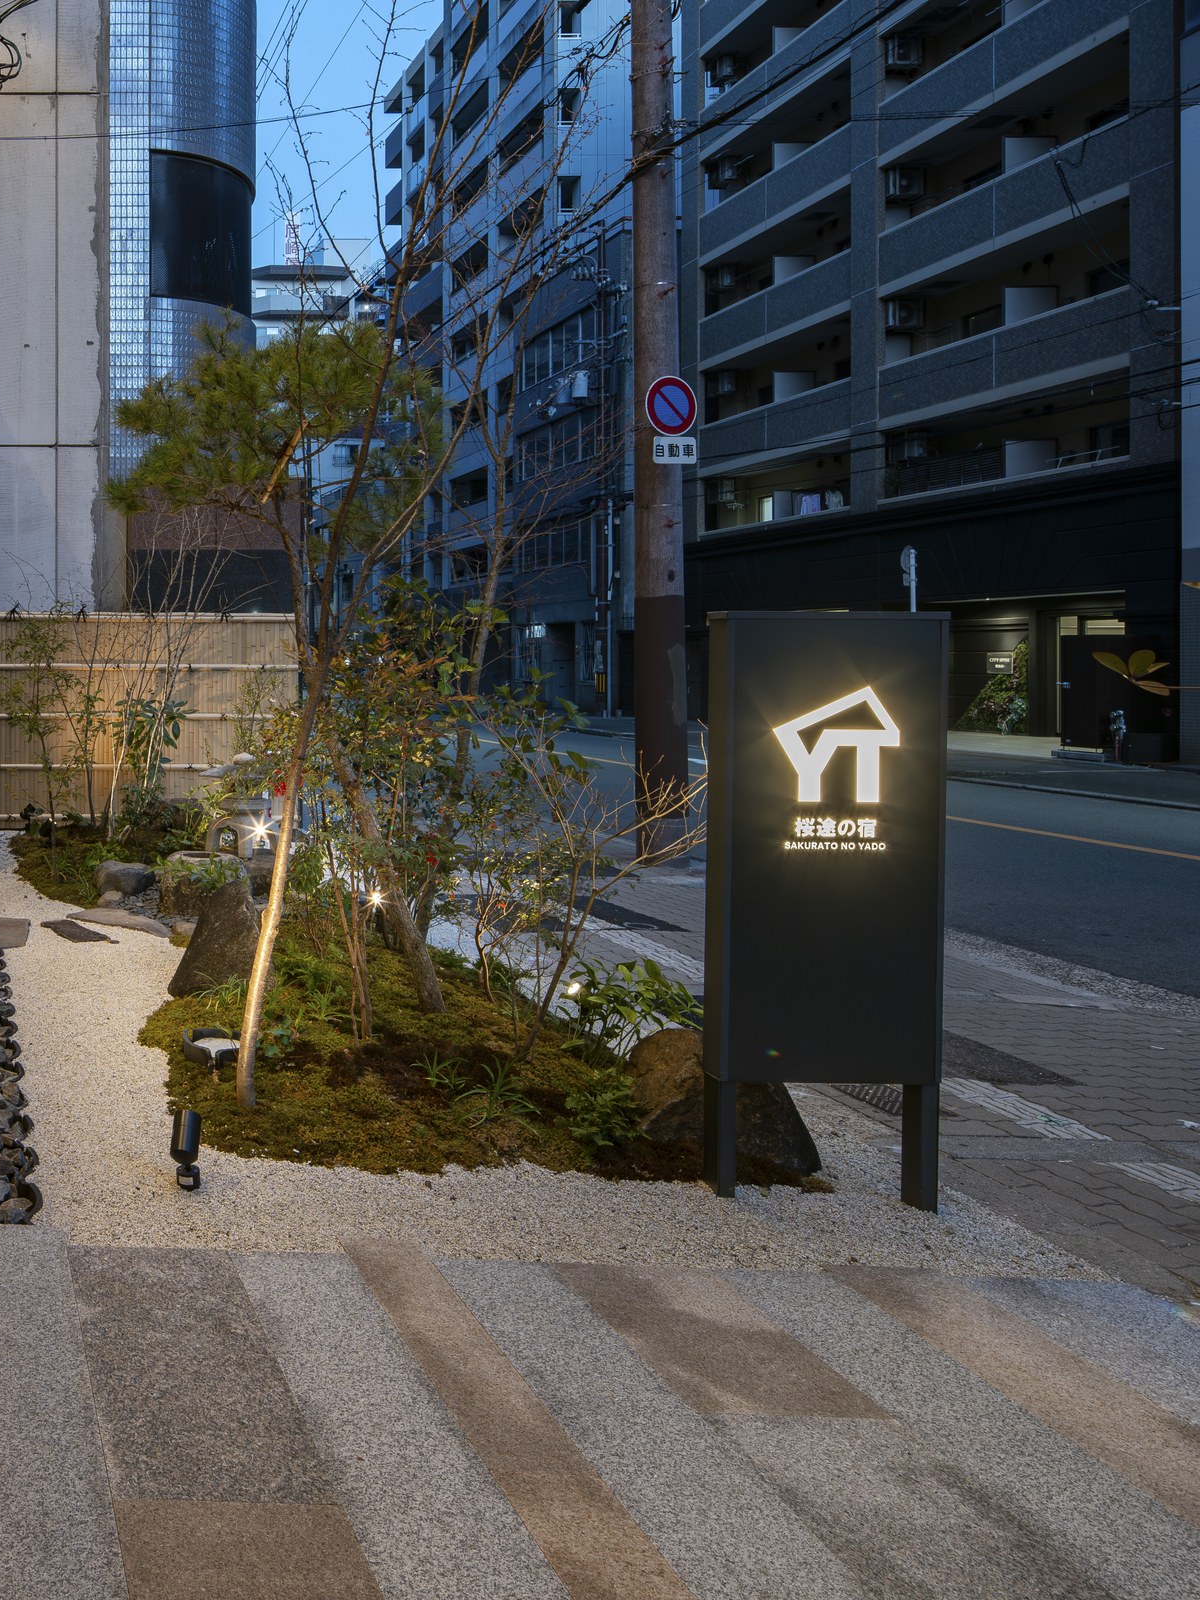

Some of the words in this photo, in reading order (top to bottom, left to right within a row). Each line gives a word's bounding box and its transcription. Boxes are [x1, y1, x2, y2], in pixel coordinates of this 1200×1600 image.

[655, 443, 695, 458] 自動車
[795, 817, 877, 838] 桜途の宿
[784, 841, 838, 850] SAKURATO
[840, 841, 856, 850] NO
[858, 842, 886, 851] YADO
